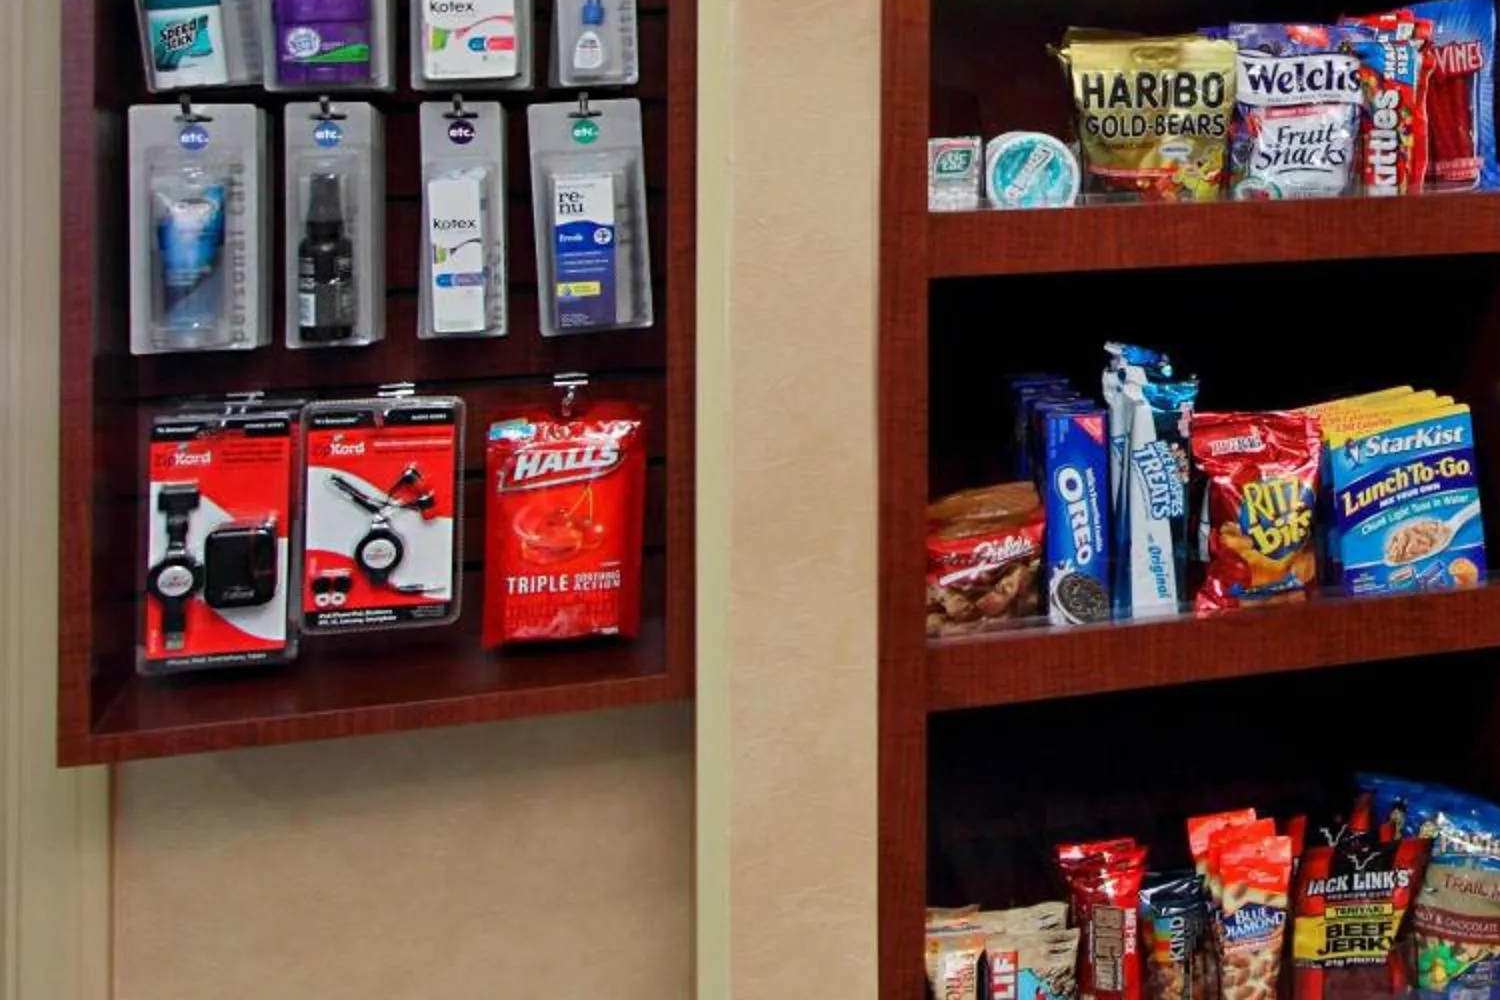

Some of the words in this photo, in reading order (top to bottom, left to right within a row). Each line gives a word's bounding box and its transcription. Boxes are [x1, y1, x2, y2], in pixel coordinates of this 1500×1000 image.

[1434, 41, 1483, 74] VINES
[1082, 71, 1225, 109] HARIBO
[180, 132, 209, 144] etc.
[450, 128, 475, 139] etc.
[1086, 114, 1225, 138] GOLD-BEARS
[1277, 123, 1334, 147] Fruit
[1256, 142, 1346, 169] Snacks
[1368, 89, 1399, 196] kittles
[229, 162, 244, 215] care
[559, 203, 584, 215] nu
[1365, 425, 1464, 457] StarKist
[514, 446, 619, 481] HALLS
[1133, 446, 1171, 520] TREATS
[1342, 467, 1409, 517] Lunch
[1057, 465, 1092, 566] OREO
[1243, 476, 1299, 526] RITZ
[508, 574, 568, 594] TRIPLE
[1149, 545, 1167, 598] Original
[1307, 875, 1350, 896] JACK
[1353, 868, 1409, 890] LINK'S
[1444, 873, 1488, 897] TRAIL
[1225, 911, 1287, 941] DIAMOND
[1235, 908, 1268, 926] BLUE
[1326, 922, 1393, 937] BEEF
[1169, 916, 1185, 961] KIND
